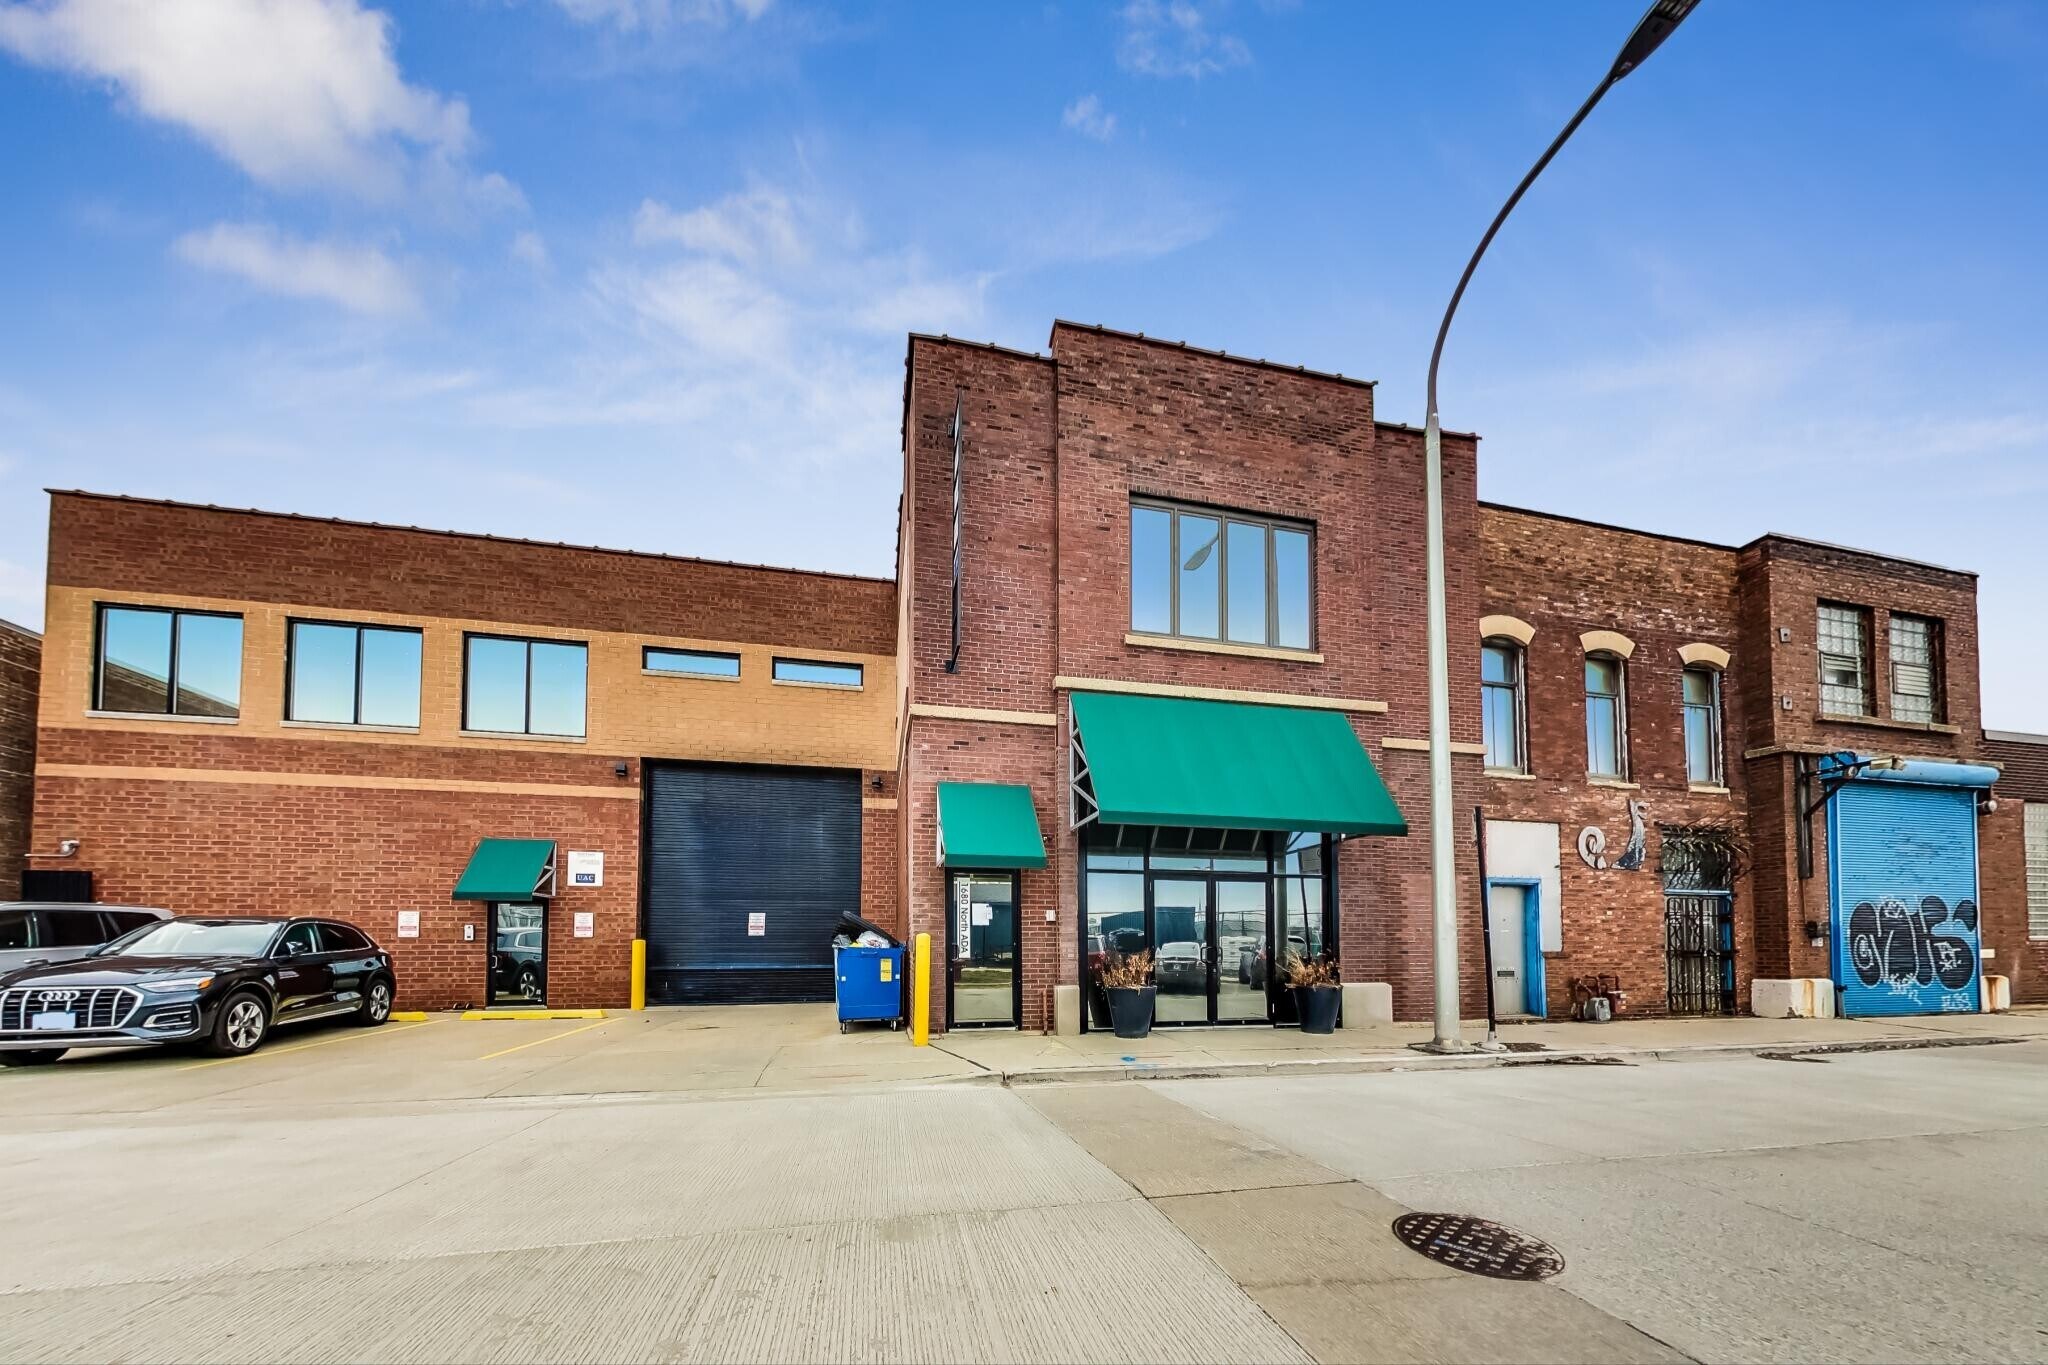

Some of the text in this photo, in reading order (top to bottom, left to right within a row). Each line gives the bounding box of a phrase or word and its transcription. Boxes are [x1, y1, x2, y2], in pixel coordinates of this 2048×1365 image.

[961, 883, 969, 953] 1680 North ADA
